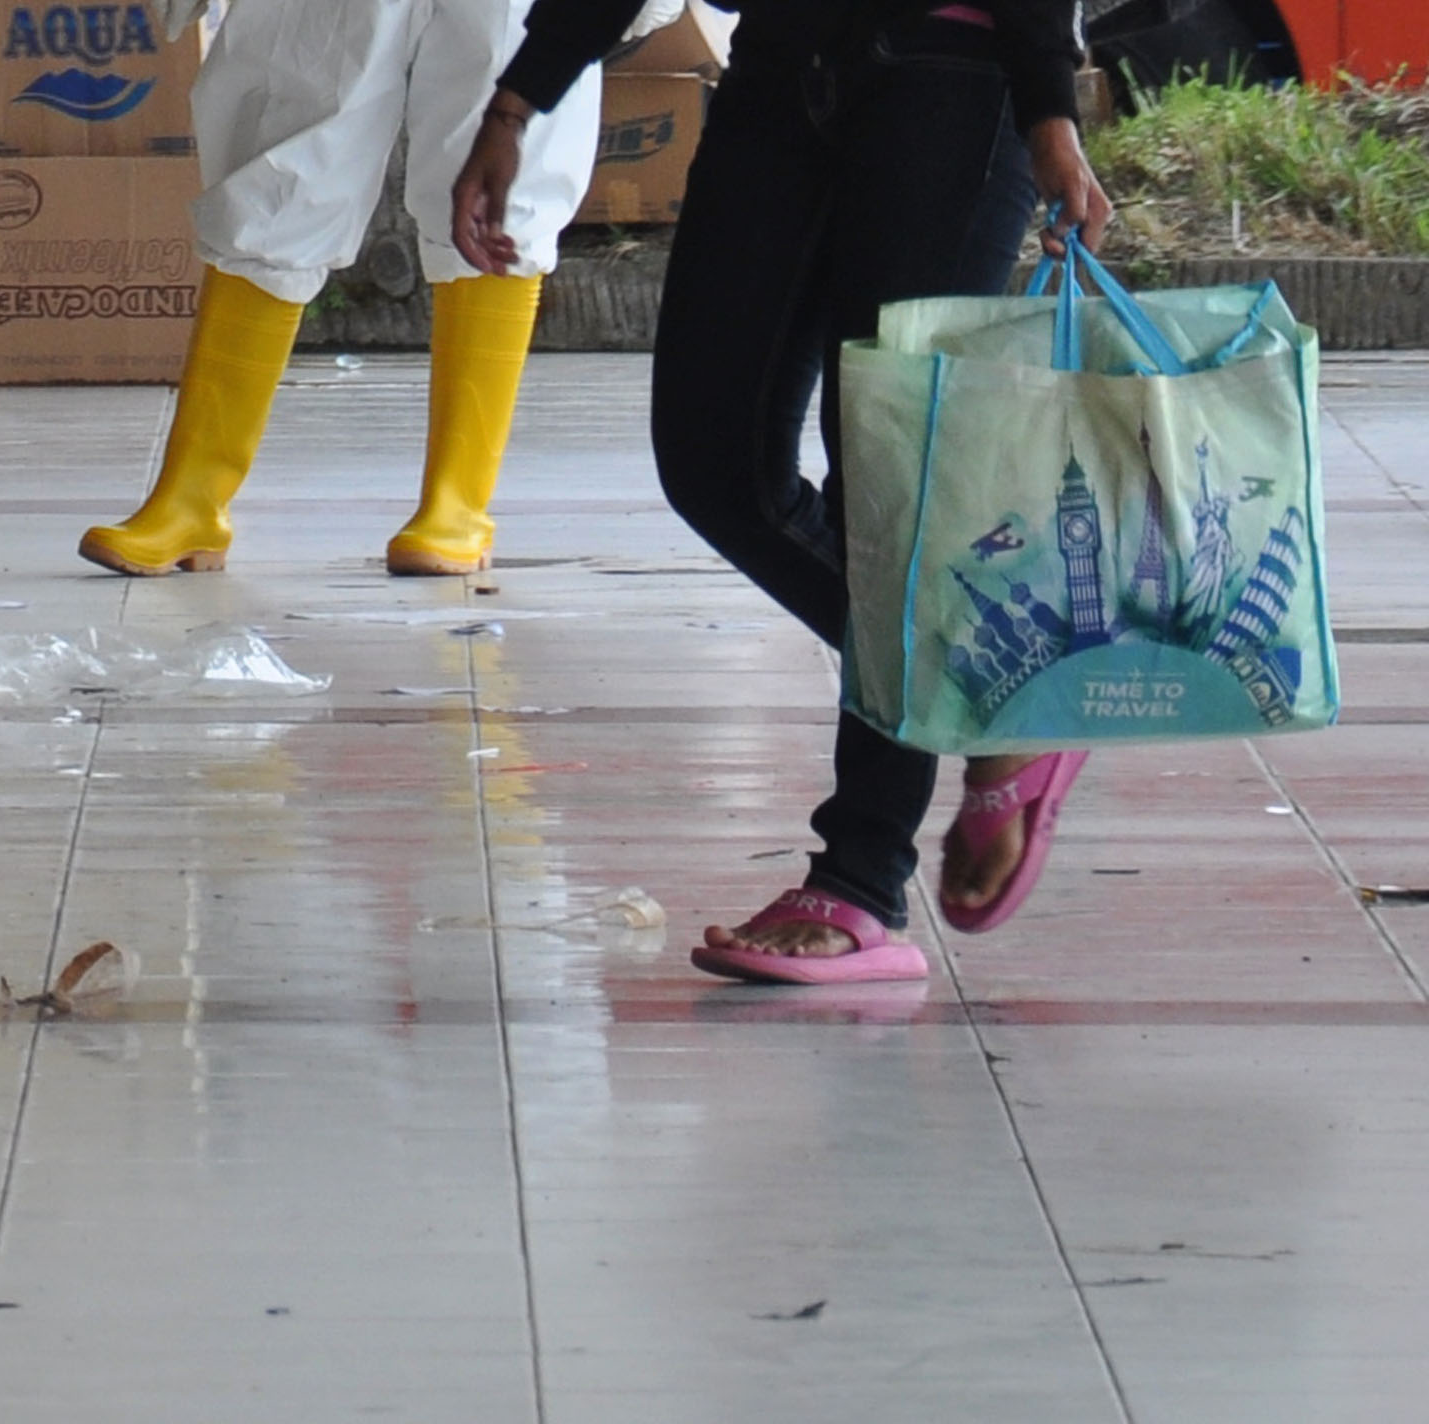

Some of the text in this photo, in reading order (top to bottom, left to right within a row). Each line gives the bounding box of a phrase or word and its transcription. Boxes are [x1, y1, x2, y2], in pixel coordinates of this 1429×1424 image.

[2, 3, 158, 67] AQUA
[0, 238, 191, 283] Coffeemix
[1085, 681, 1185, 699] TIME TO
[1081, 700, 1180, 718] TRAVEL
